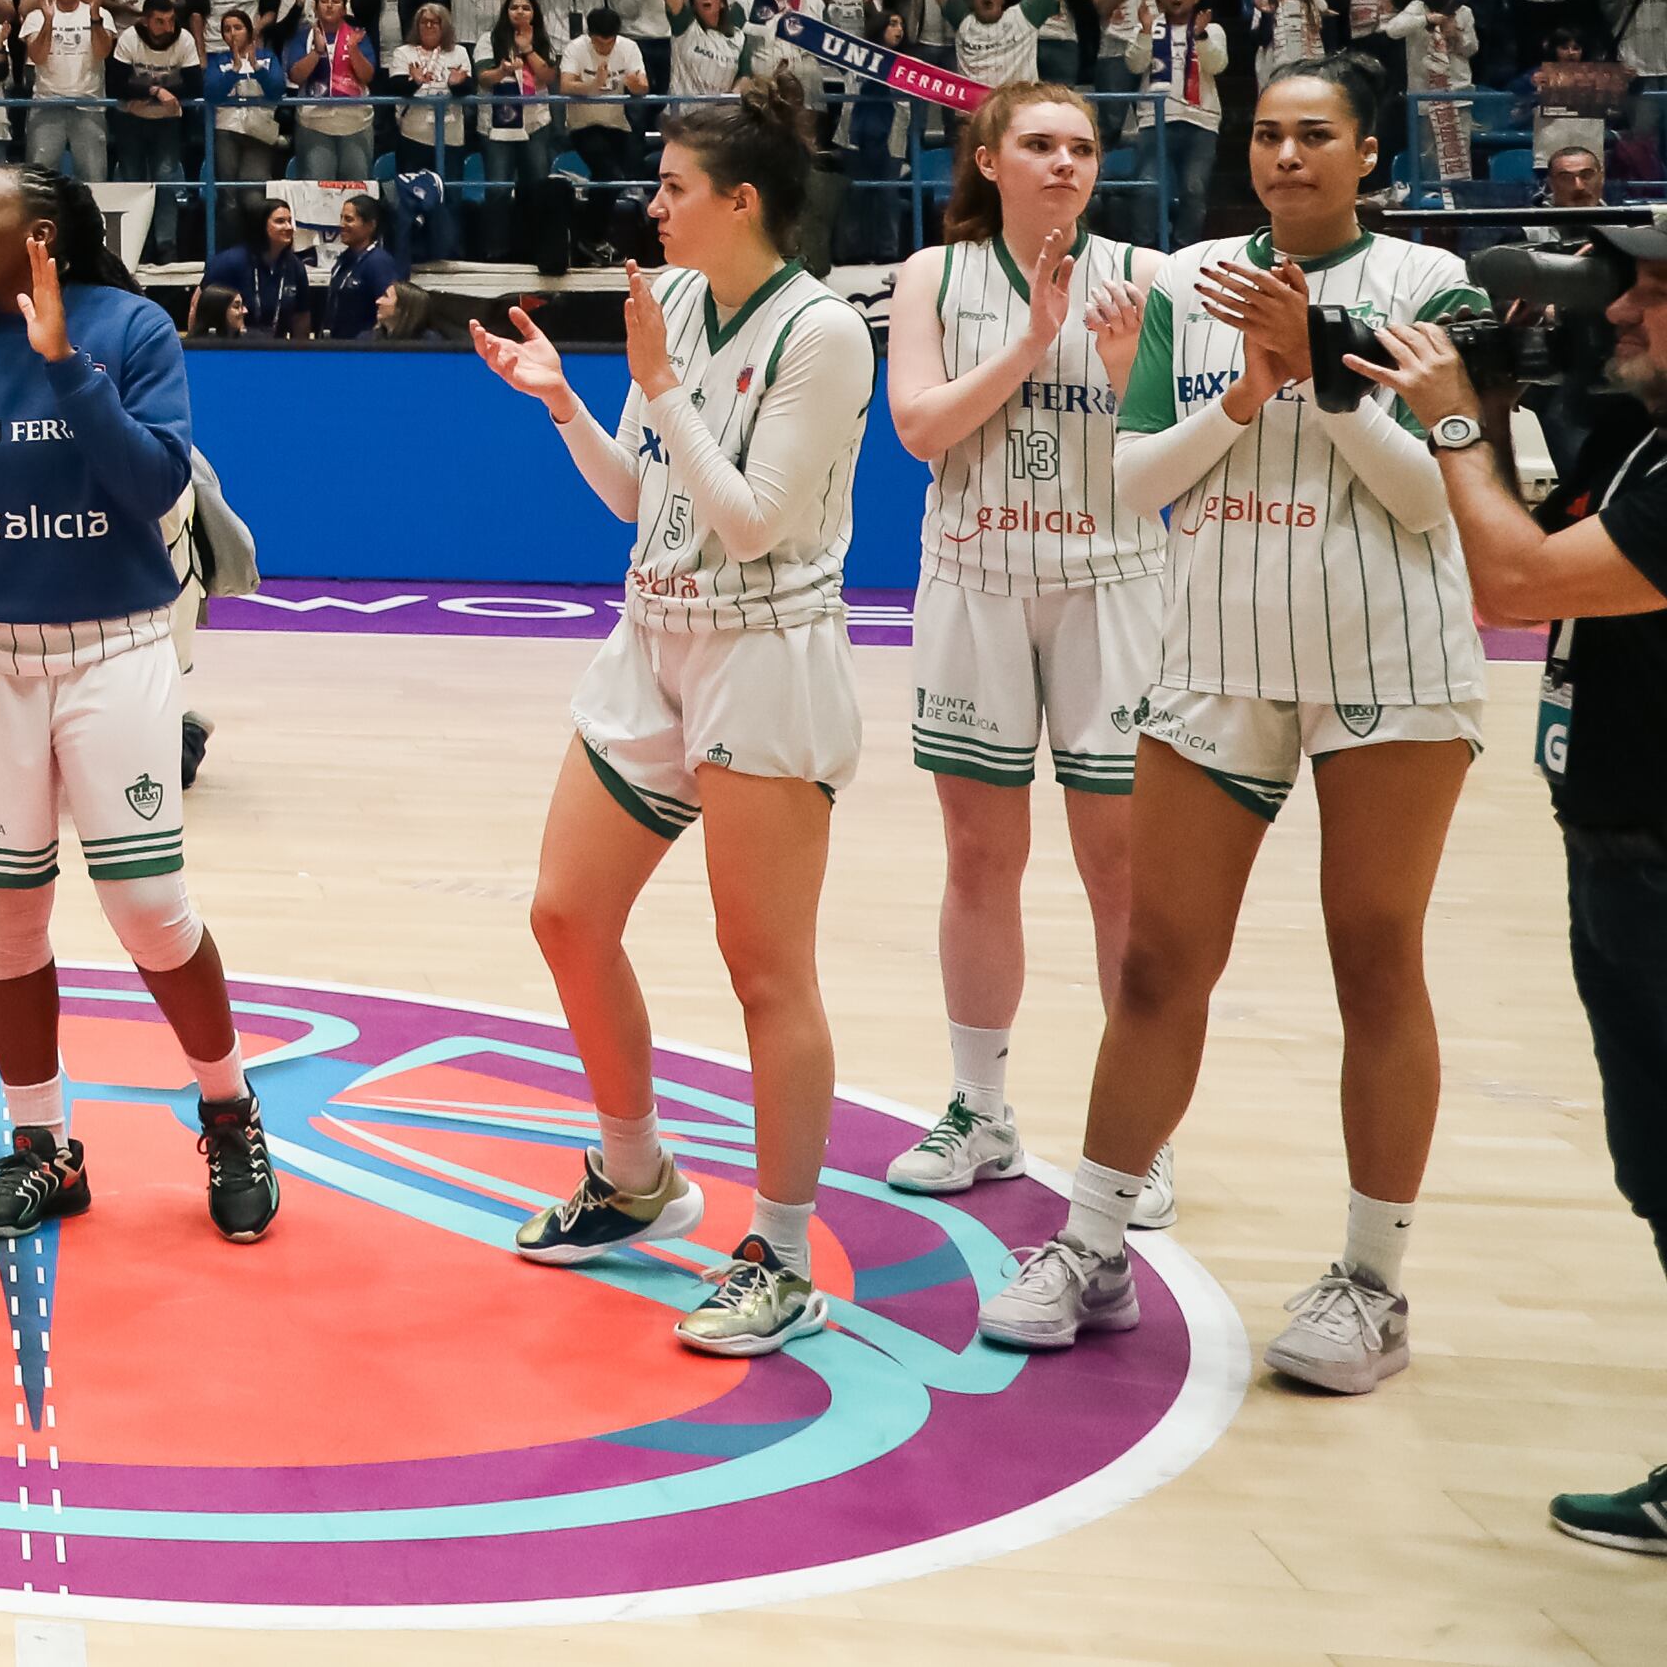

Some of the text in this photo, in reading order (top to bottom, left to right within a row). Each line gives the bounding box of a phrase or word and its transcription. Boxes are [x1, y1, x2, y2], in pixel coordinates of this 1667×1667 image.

[821, 33, 969, 102] UNI FERROL
[1008, 429, 1058, 481] 13
[663, 493, 691, 551] 5
[943, 500, 1096, 543] galicia
[1181, 490, 1317, 536] galicia
[926, 705, 1000, 734] DE GALICIA
[927, 693, 977, 713] XUNTA
[133, 791, 159, 803] BAXI
